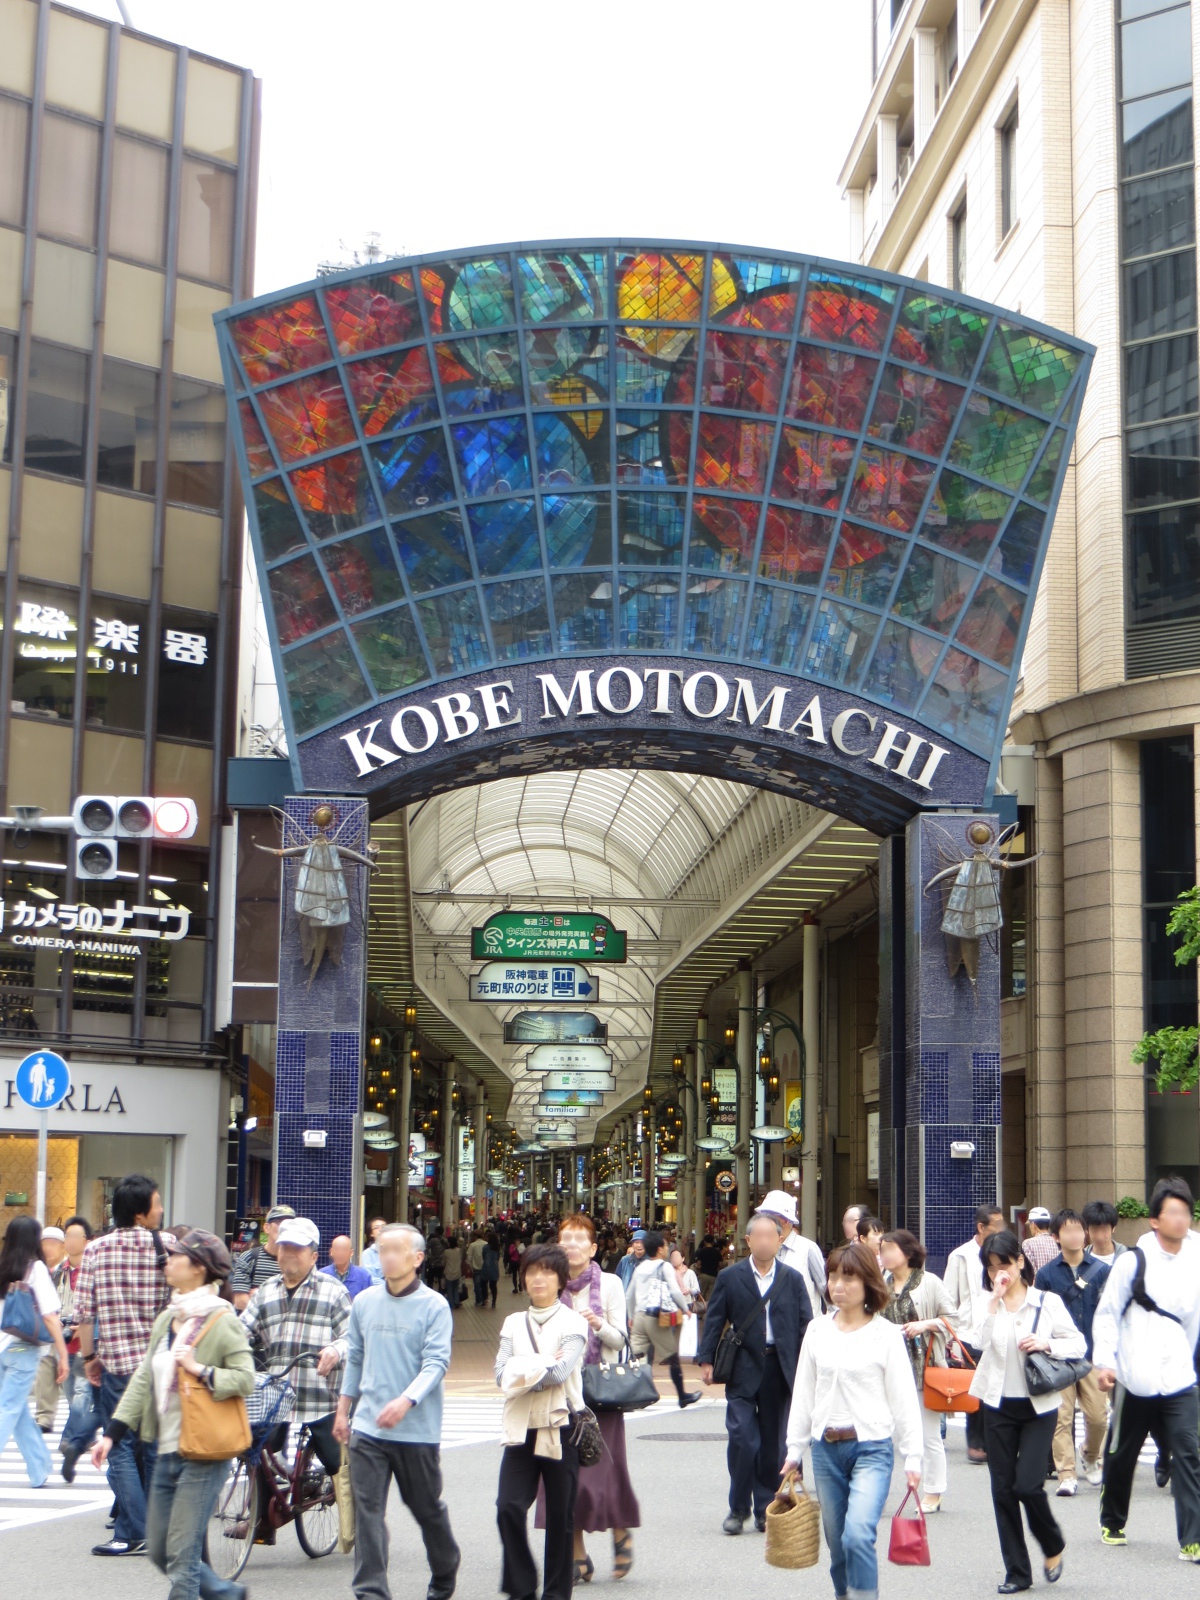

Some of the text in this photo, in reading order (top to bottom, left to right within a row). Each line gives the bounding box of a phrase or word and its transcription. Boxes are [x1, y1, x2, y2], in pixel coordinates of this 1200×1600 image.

[94, 656, 139, 675] 1911
[340, 666, 951, 792] KOBE MOTOMACHI
[12, 899, 190, 941] カメラのナニワ
[12, 934, 142, 955] CAMERA-NANIWA
[483, 945, 503, 954] JRA
[506, 937, 590, 950] ウインズ神戸A館
[505, 969, 549, 980] 阪神電車
[477, 981, 549, 995] 元町駅のりば
[4, 1081, 127, 1113] FRLA
